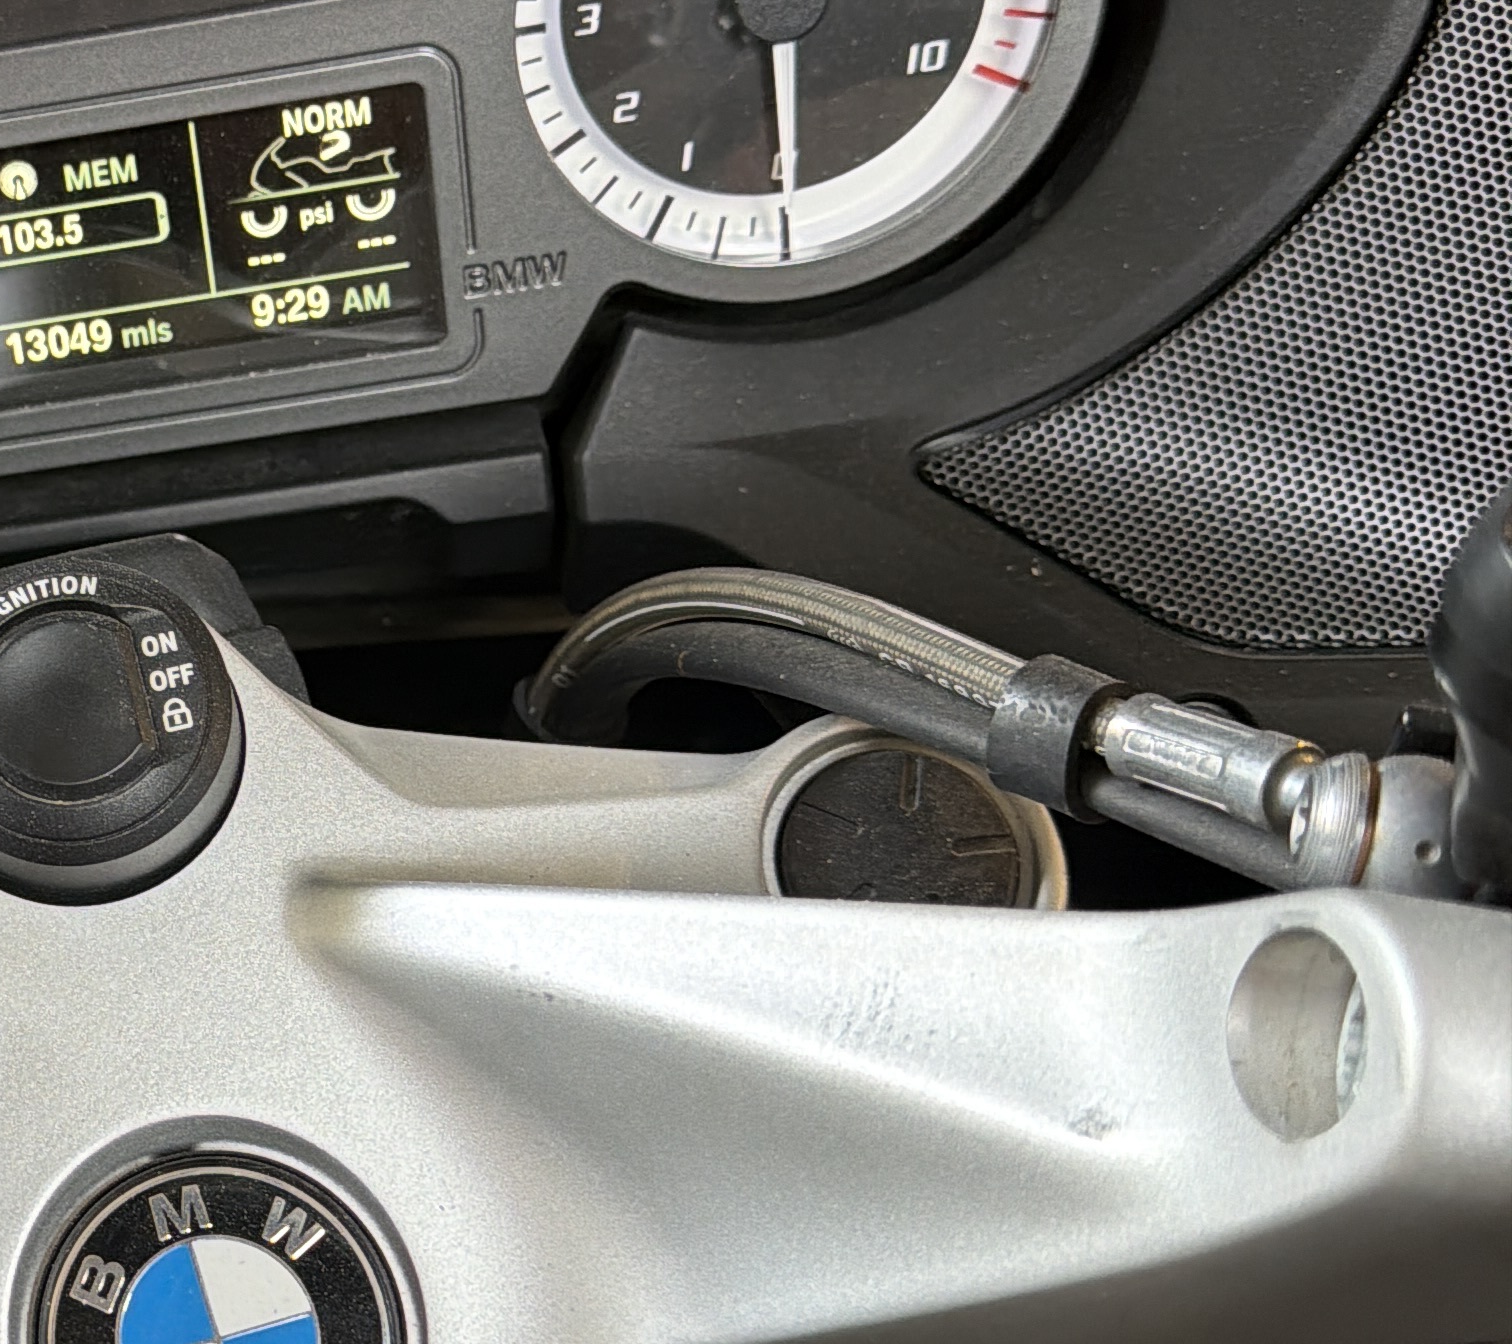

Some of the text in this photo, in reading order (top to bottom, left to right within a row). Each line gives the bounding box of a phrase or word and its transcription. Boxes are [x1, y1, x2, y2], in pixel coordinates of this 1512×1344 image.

[575, 3, 601, 37] 3
[906, 39, 949, 75] 10
[282, 97, 372, 138] NORM
[612, 90, 641, 123] 2
[63, 155, 138, 192] MEM
[681, 141, 695, 172] 1
[299, 202, 333, 231] psi
[463, 250, 567, 300] BMW
[252, 283, 390, 327] 9:29 AM
[6, 317, 173, 365] 13049 mls
[141, 631, 178, 657] ON
[149, 663, 194, 692] OFF
[68, 1184, 326, 1314] BMW
